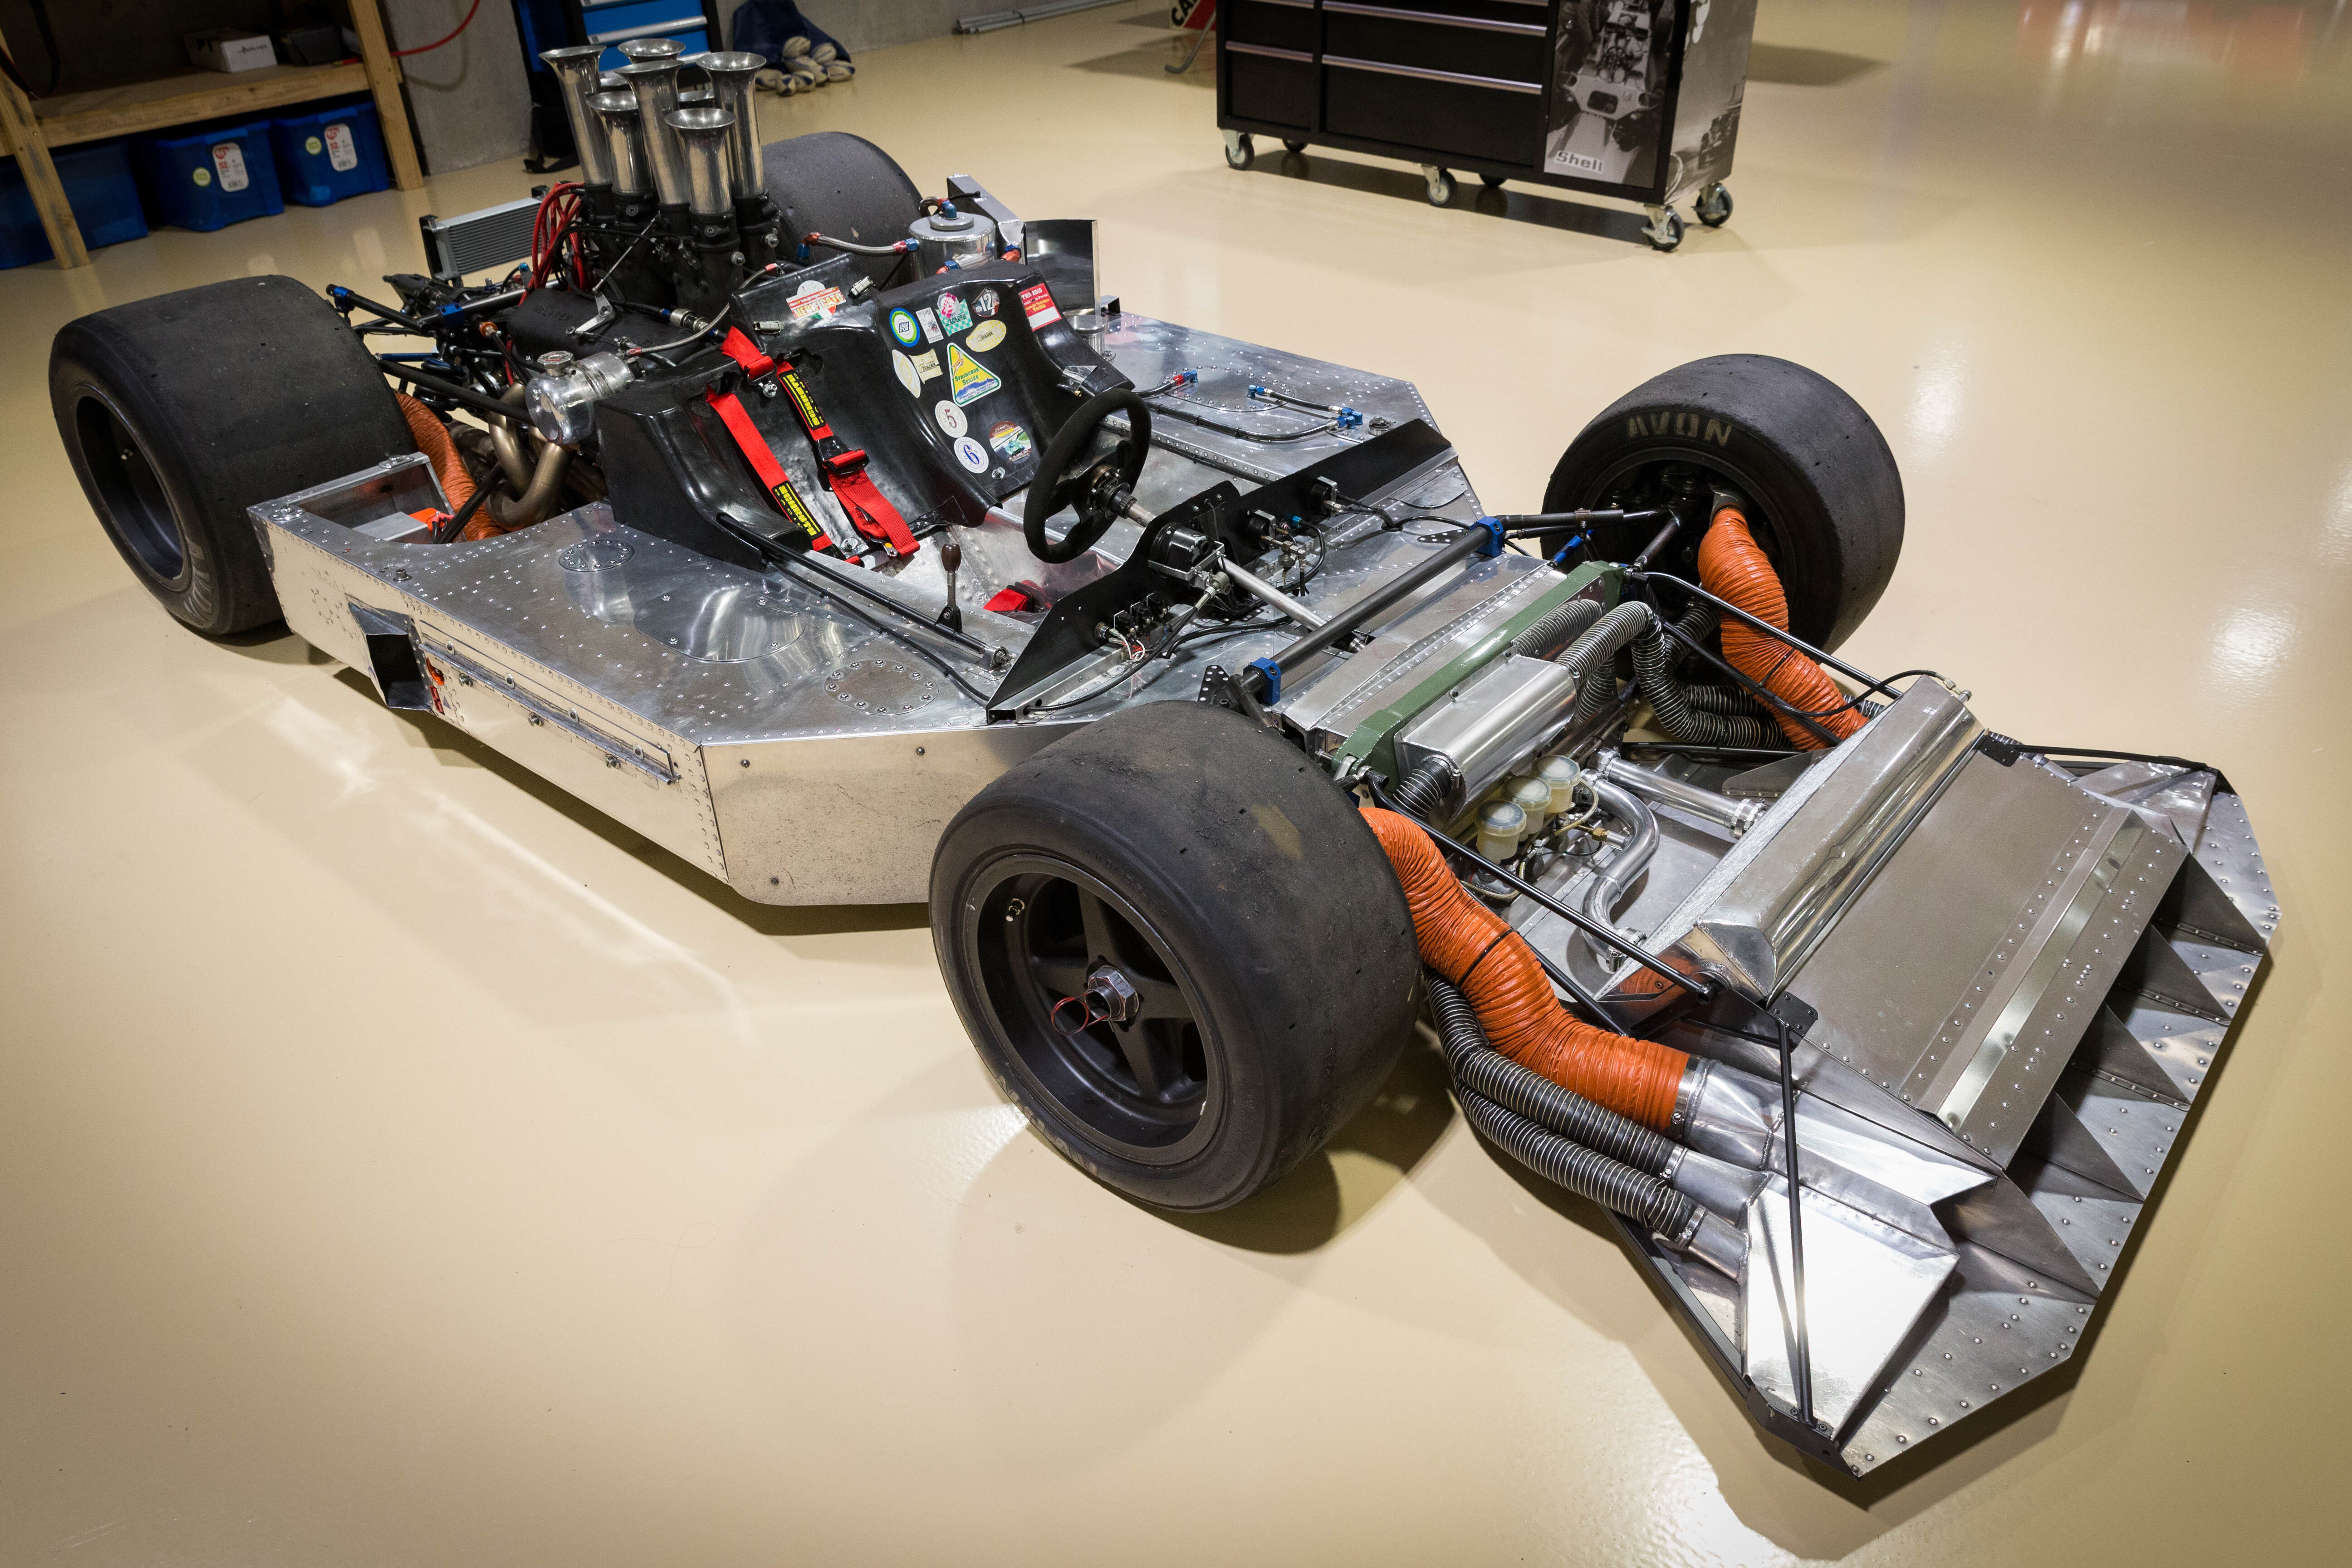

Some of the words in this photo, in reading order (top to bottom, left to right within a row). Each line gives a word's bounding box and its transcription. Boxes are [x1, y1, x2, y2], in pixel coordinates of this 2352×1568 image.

[1556, 152, 1602, 172] Shell
[1031, 288, 1043, 296] 2010
[978, 293, 995, 312] 12
[950, 314, 966, 324] ZOLDER
[980, 331, 994, 341] ZOLDER
[922, 363, 936, 371] ZOLDER
[786, 374, 820, 426] SCHROTH
[945, 408, 957, 428] 5
[1629, 411, 1733, 446] AVON
[963, 445, 980, 465] 6
[779, 485, 817, 536] SCHROTH
